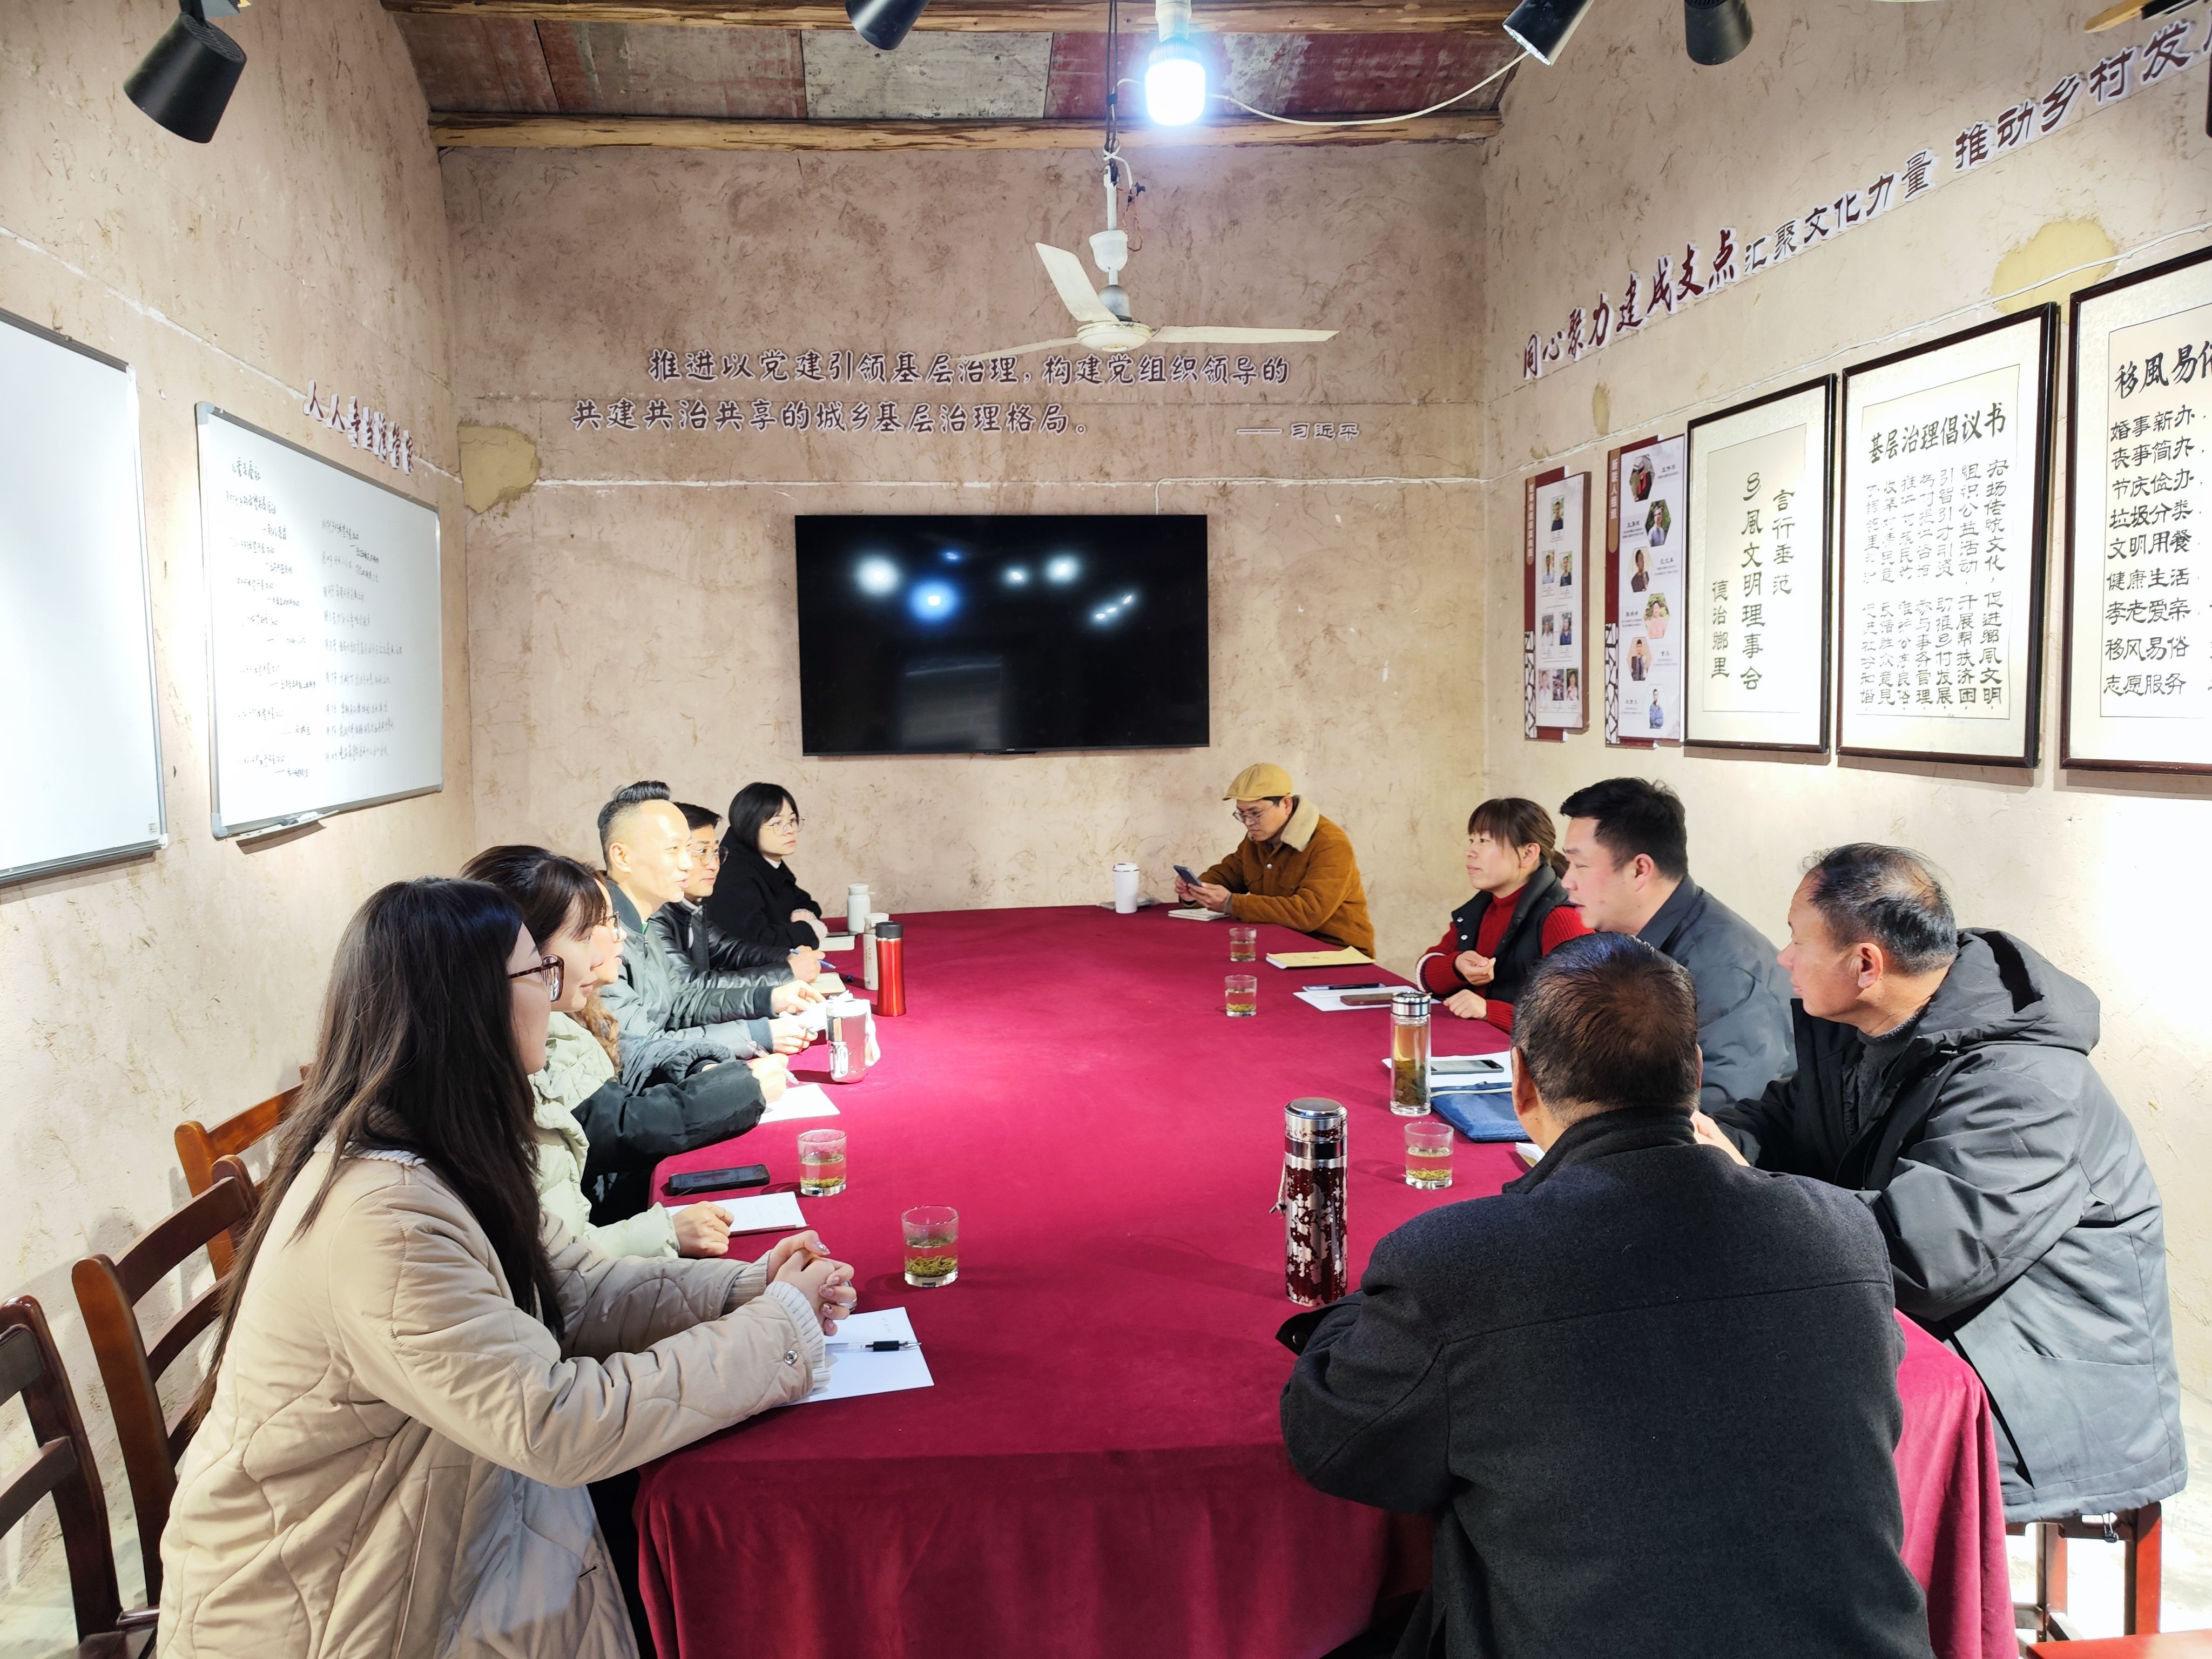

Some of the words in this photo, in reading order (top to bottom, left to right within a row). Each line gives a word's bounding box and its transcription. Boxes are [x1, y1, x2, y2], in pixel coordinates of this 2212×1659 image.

[1744, 149, 1941, 274] 汇聚文化力量
[1954, 10, 2212, 173] 推动乡村发
[2114, 340, 2212, 399] 移風易
[571, 399, 1088, 434] 共建共治共享的城乡基层治理格局。
[1869, 402, 2006, 463] 基层治理倡议书
[1772, 489, 1795, 595] 言行垂范
[2105, 636, 2190, 661] 移风易俗
[2103, 673, 2187, 696] 志愿服务
